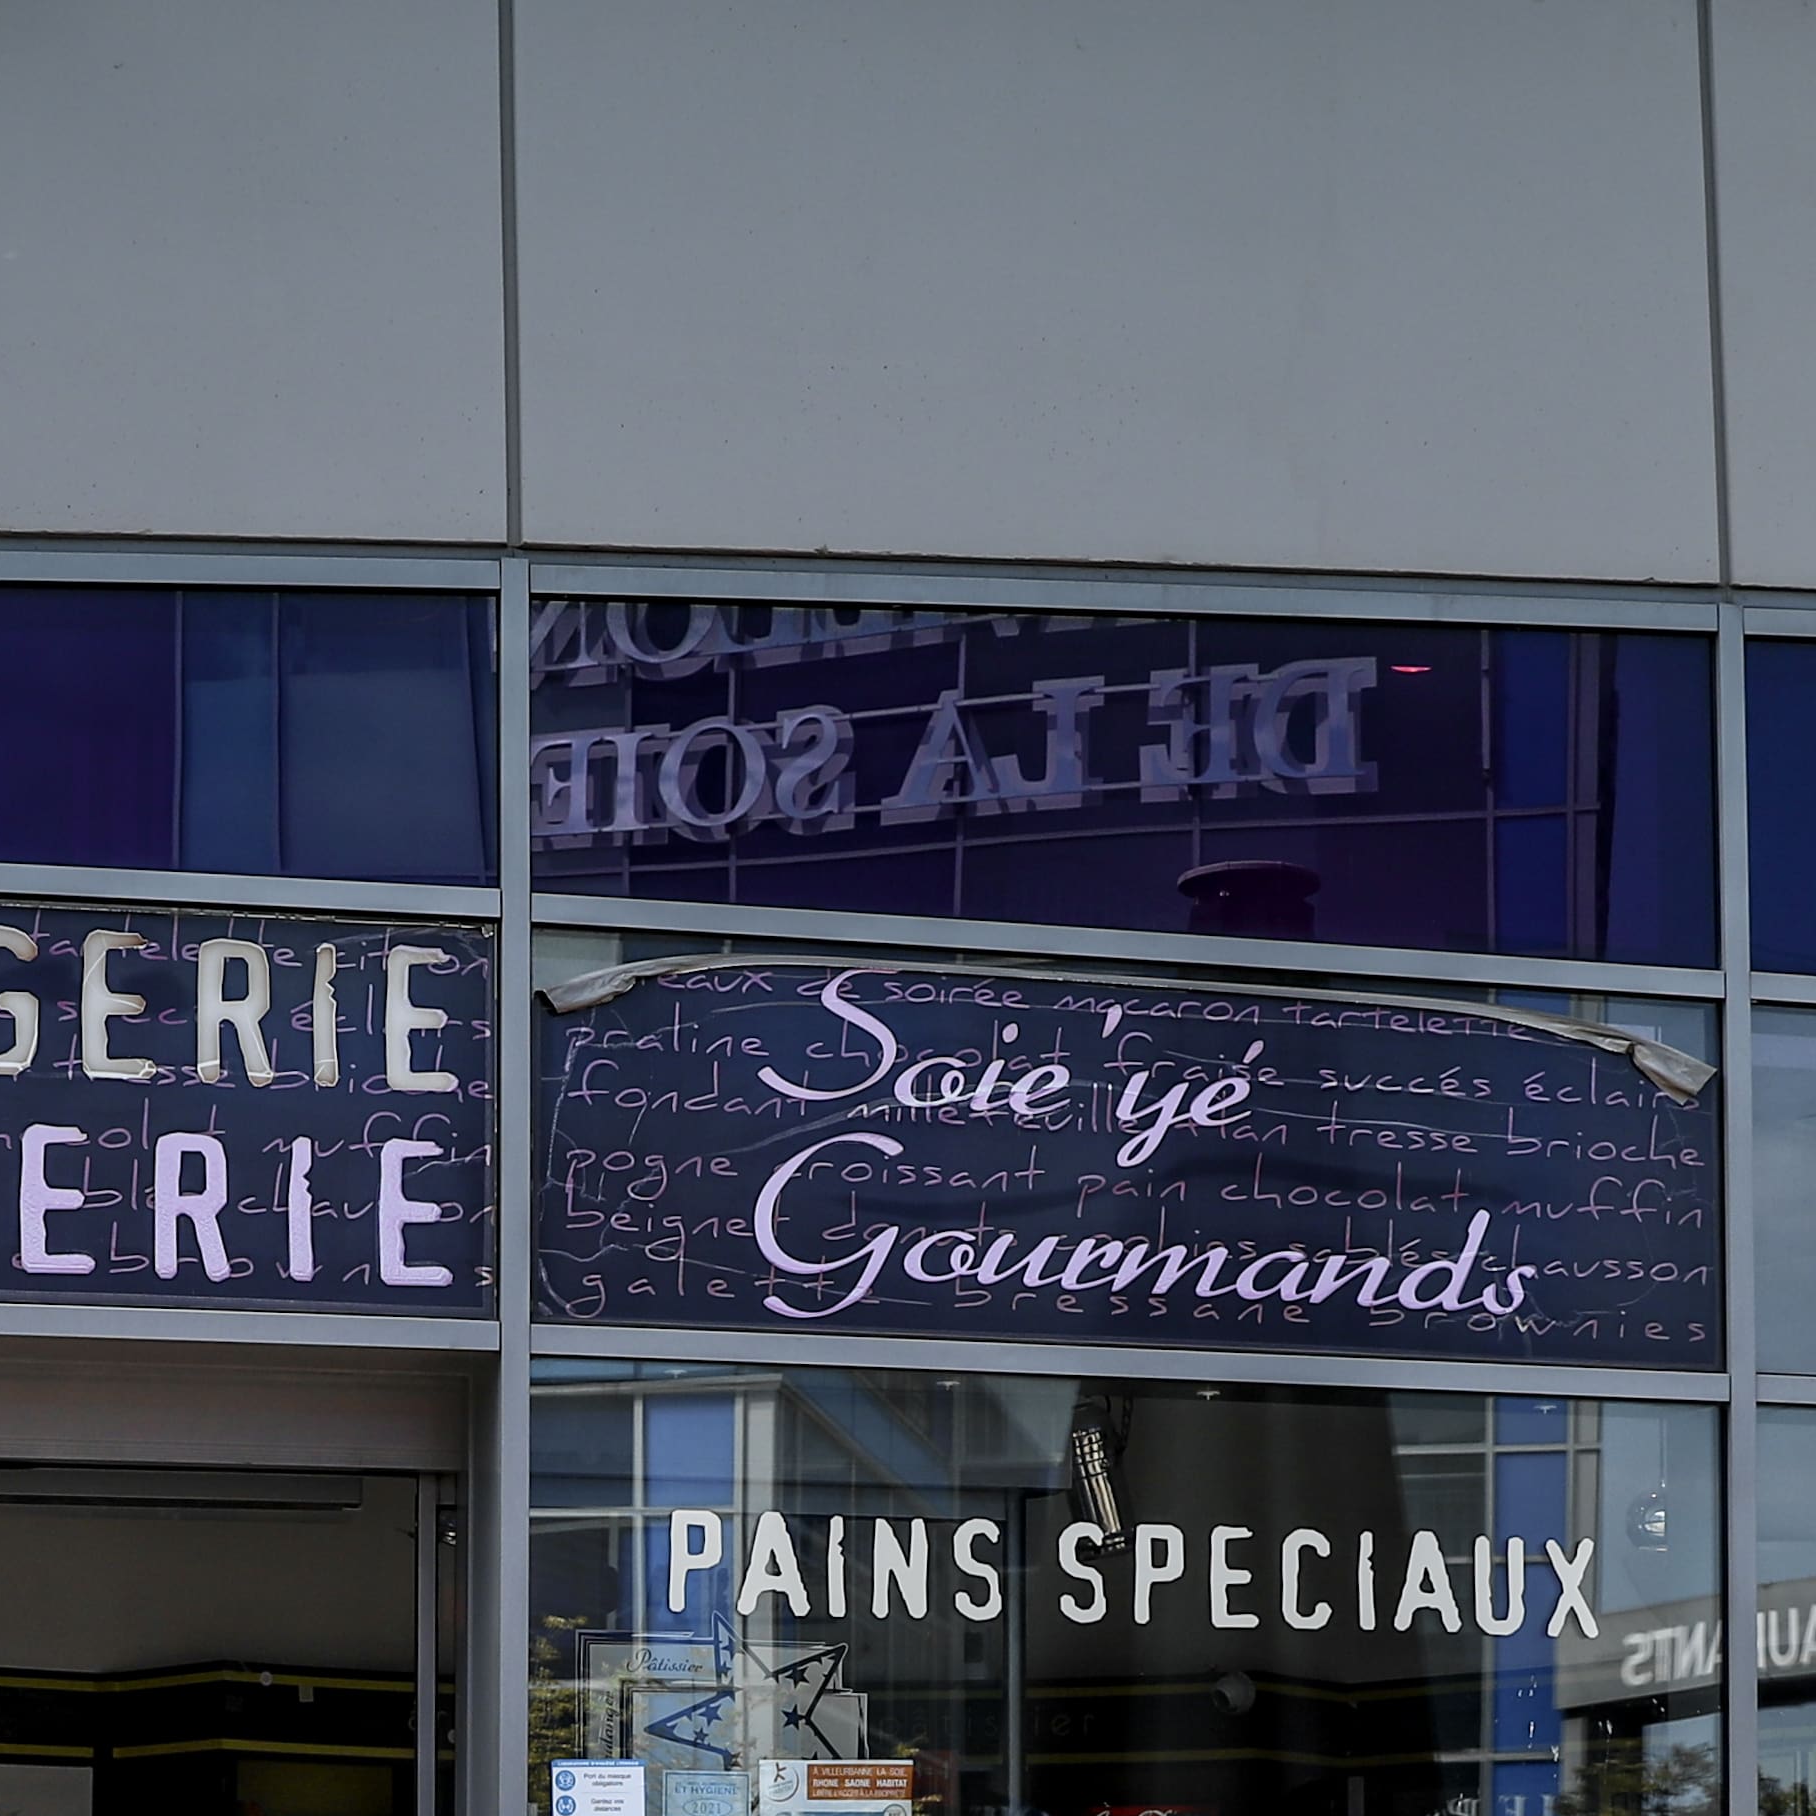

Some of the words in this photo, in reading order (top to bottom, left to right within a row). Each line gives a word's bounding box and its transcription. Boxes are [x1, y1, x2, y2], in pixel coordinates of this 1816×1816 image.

[757, 969, 1071, 1116] Soie
[1317, 1100, 1478, 1153] tresse
[1507, 1107, 1705, 1169] brioche
[566, 1150, 739, 1200] pogne
[1077, 1168, 1185, 1218] pain
[1220, 1152, 1469, 1212] chocolat
[1501, 1176, 1703, 1230] muffin
[754, 1132, 1539, 1318] Gourmands
[668, 1509, 1003, 1622] PAINS
[1058, 1521, 1599, 1638] SPECIAUX
[626, 1648, 703, 1674] Pâtissier
[692, 1801, 722, 1814] 2021
